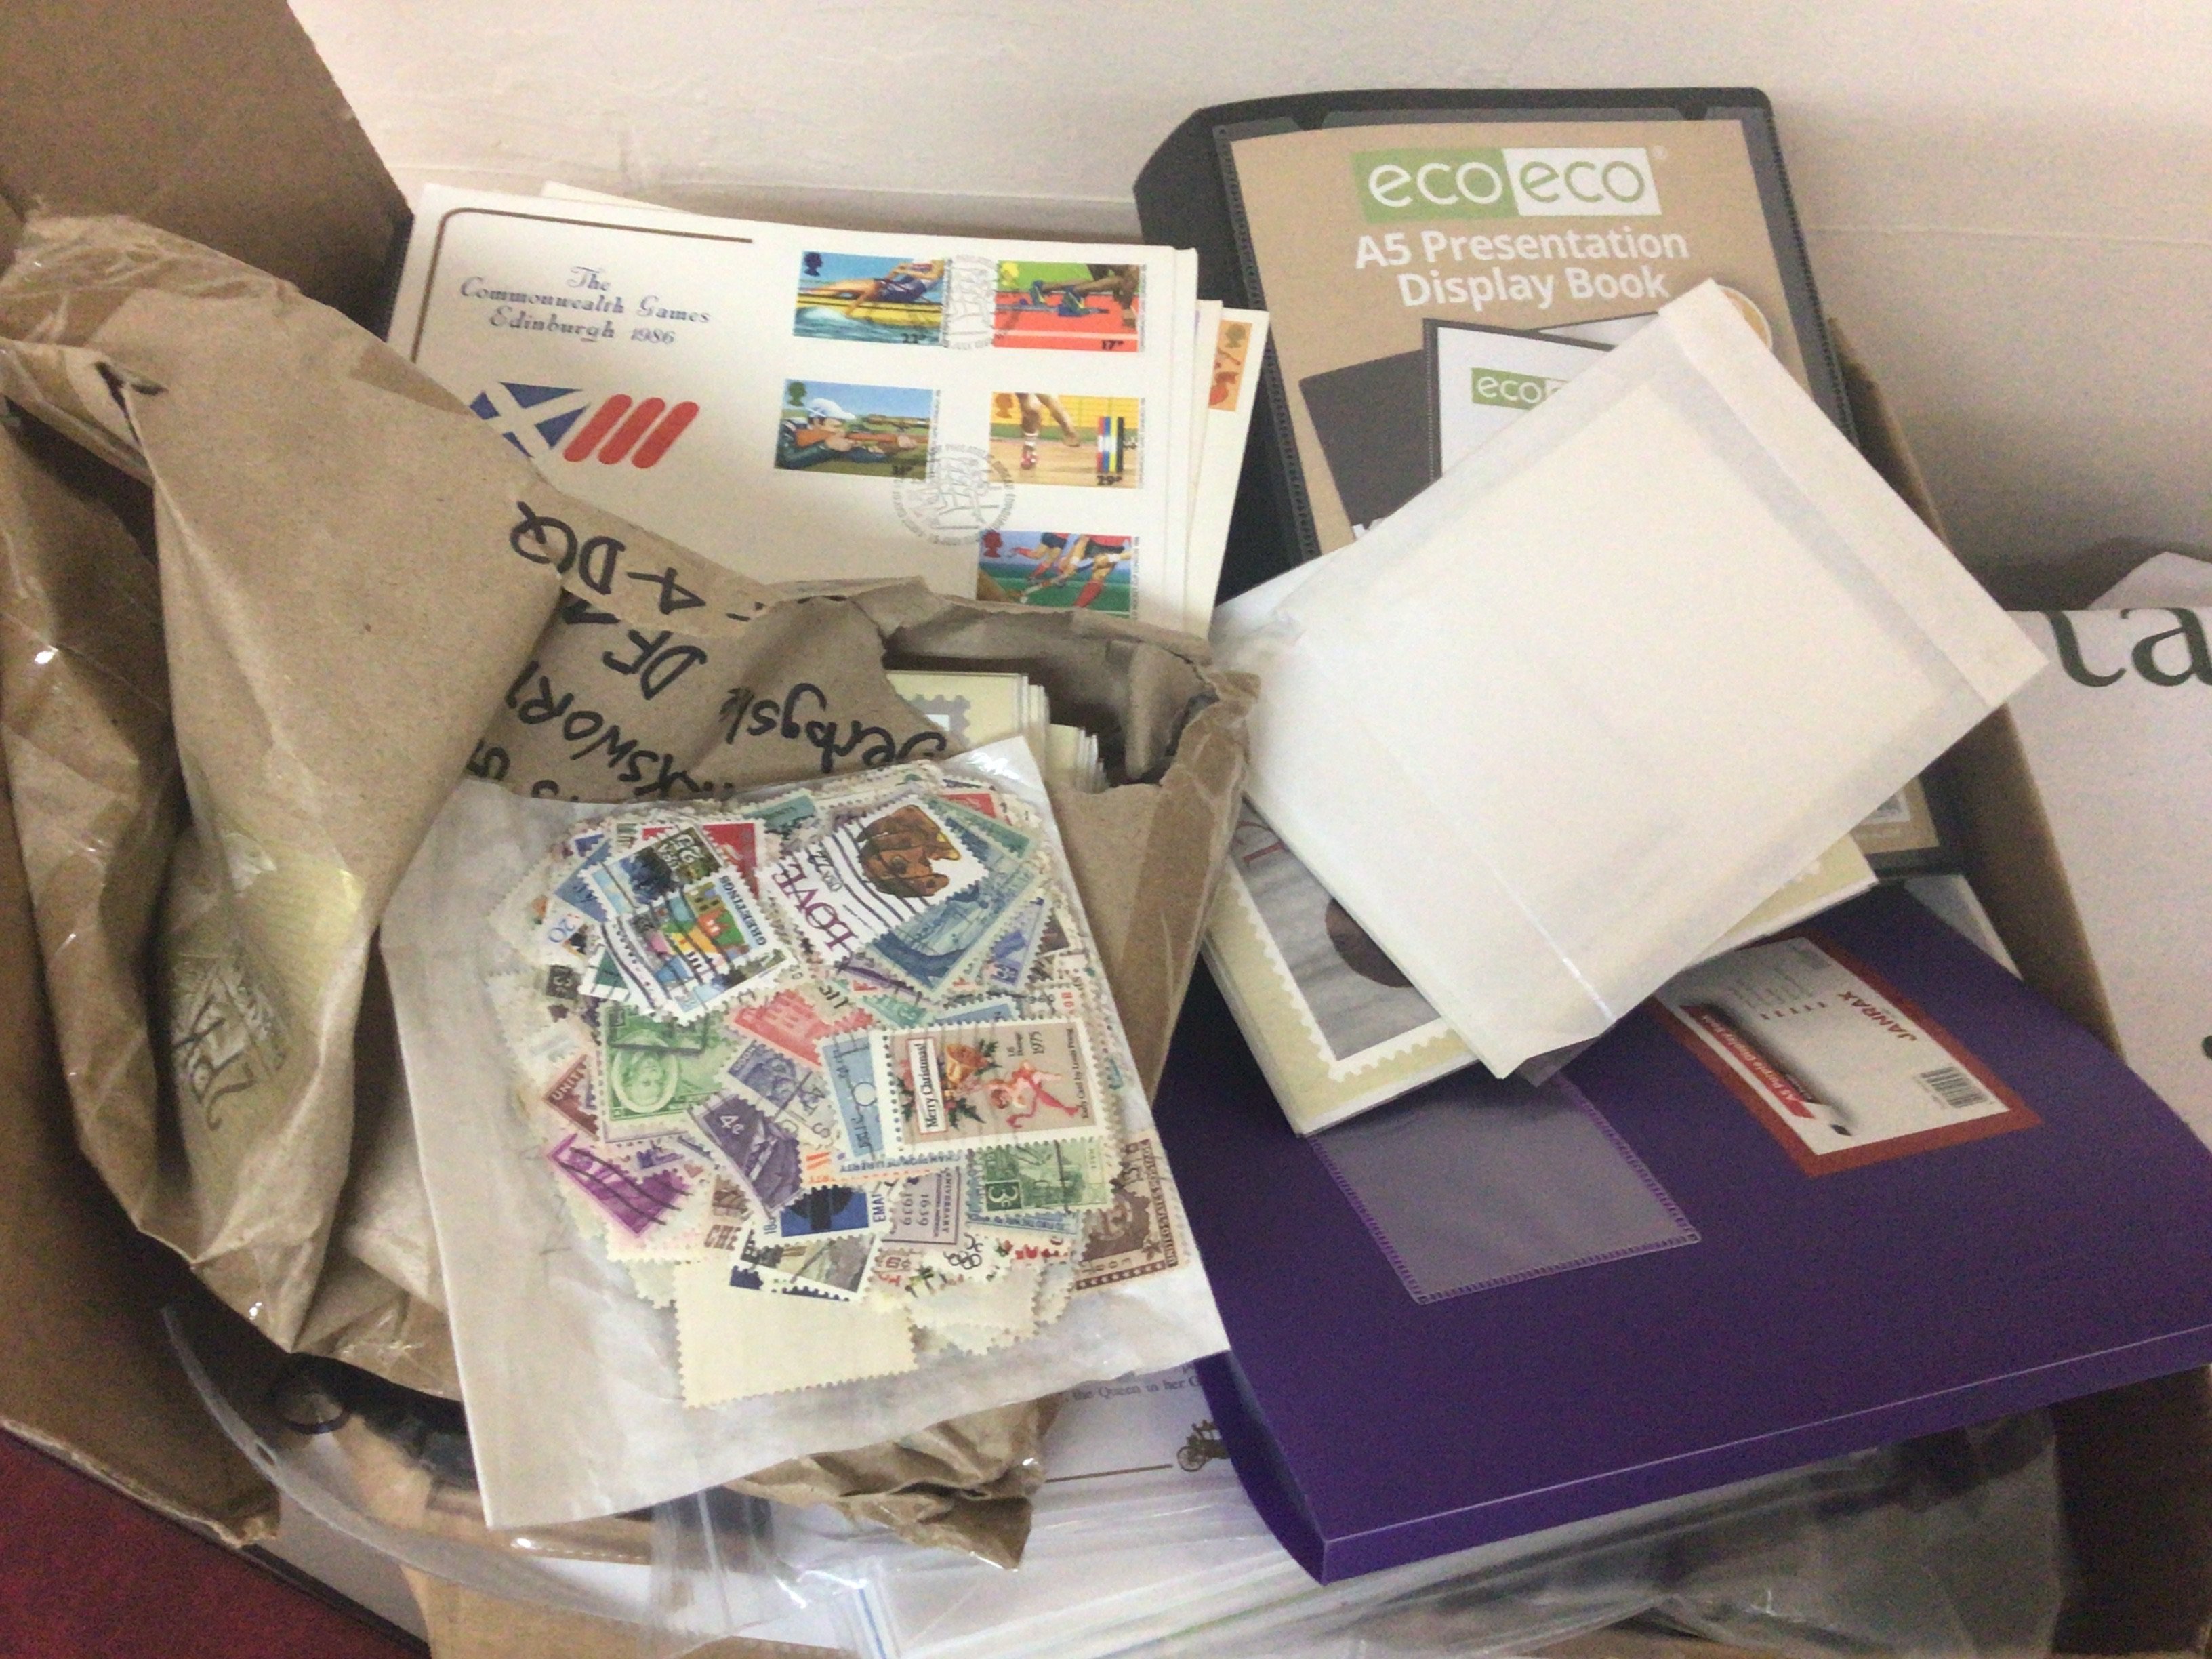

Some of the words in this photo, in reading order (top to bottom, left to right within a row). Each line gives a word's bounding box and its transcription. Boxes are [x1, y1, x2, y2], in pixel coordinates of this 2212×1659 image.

[1355, 232, 1411, 269] A5
[1421, 226, 1689, 264] Presentation
[567, 266, 610, 291] The
[1399, 267, 1554, 310] Display
[1569, 266, 1669, 300] Book
[460, 276, 624, 314] Commonwealth
[636, 295, 711, 323] Games
[489, 306, 615, 342] Edinburgh
[631, 327, 676, 344] 1986
[720, 875, 768, 946] GREETINGS
[772, 863, 854, 953] LOVE
[1837, 990, 1917, 1042] JANRAX
[1029, 1031, 1045, 1055] 1975
[913, 1042, 934, 1095] Christmas!
[924, 1095, 941, 1128] Merry
[901, 1193, 914, 1226] 1939
[917, 1193, 931, 1227] 1639
[1098, 1384, 1141, 1399] Queen
[1145, 1384, 1159, 1392] in
[1162, 1378, 1186, 1390] her
